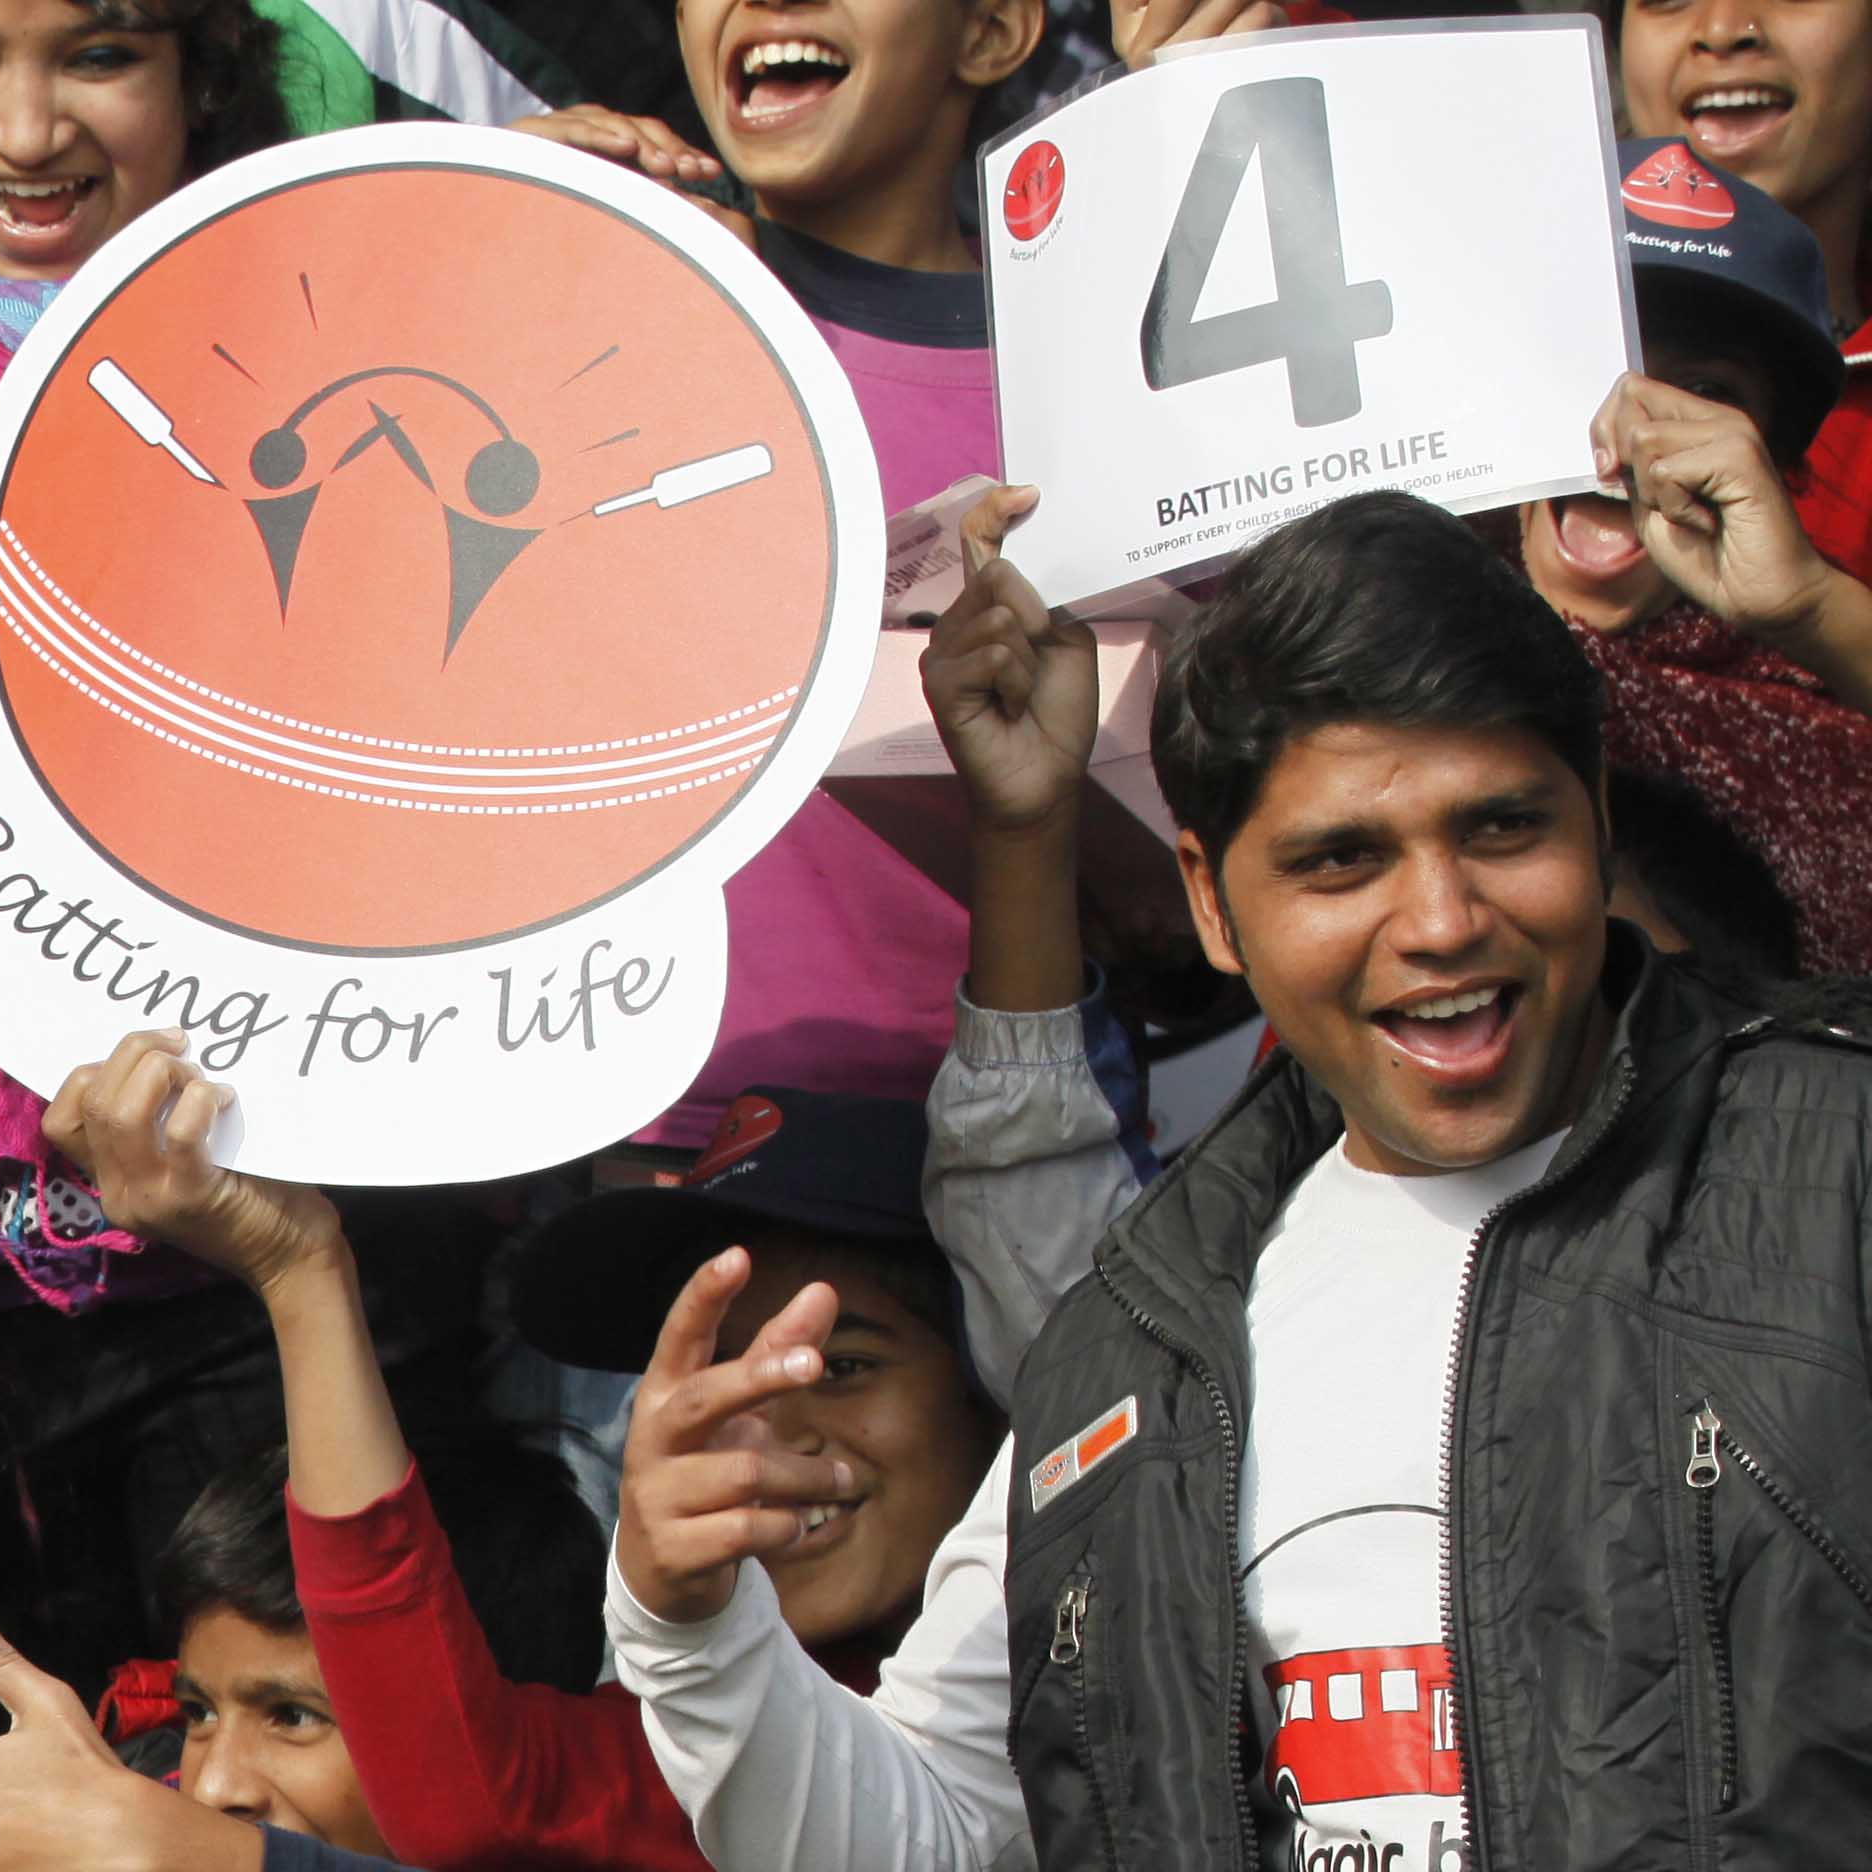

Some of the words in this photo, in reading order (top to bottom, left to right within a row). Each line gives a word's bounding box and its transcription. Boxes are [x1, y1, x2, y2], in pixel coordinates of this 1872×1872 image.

[1140, 77, 1394, 430] 4
[1683, 240, 1706, 253] for
[1126, 551, 1141, 563] TO
[1143, 534, 1193, 558] SUPPORT
[1197, 523, 1233, 542] EVERY
[1235, 510, 1281, 531] CHILD'S
[1284, 500, 1324, 518] RIGHT
[1404, 473, 1442, 491] GOOD
[1446, 464, 1494, 482] HEALTH
[1156, 465, 1294, 527] BATTING
[1304, 448, 1372, 488] FOR
[1380, 431, 1448, 470] LIFE
[298, 978, 459, 1077] for
[487, 939, 676, 1051] life
